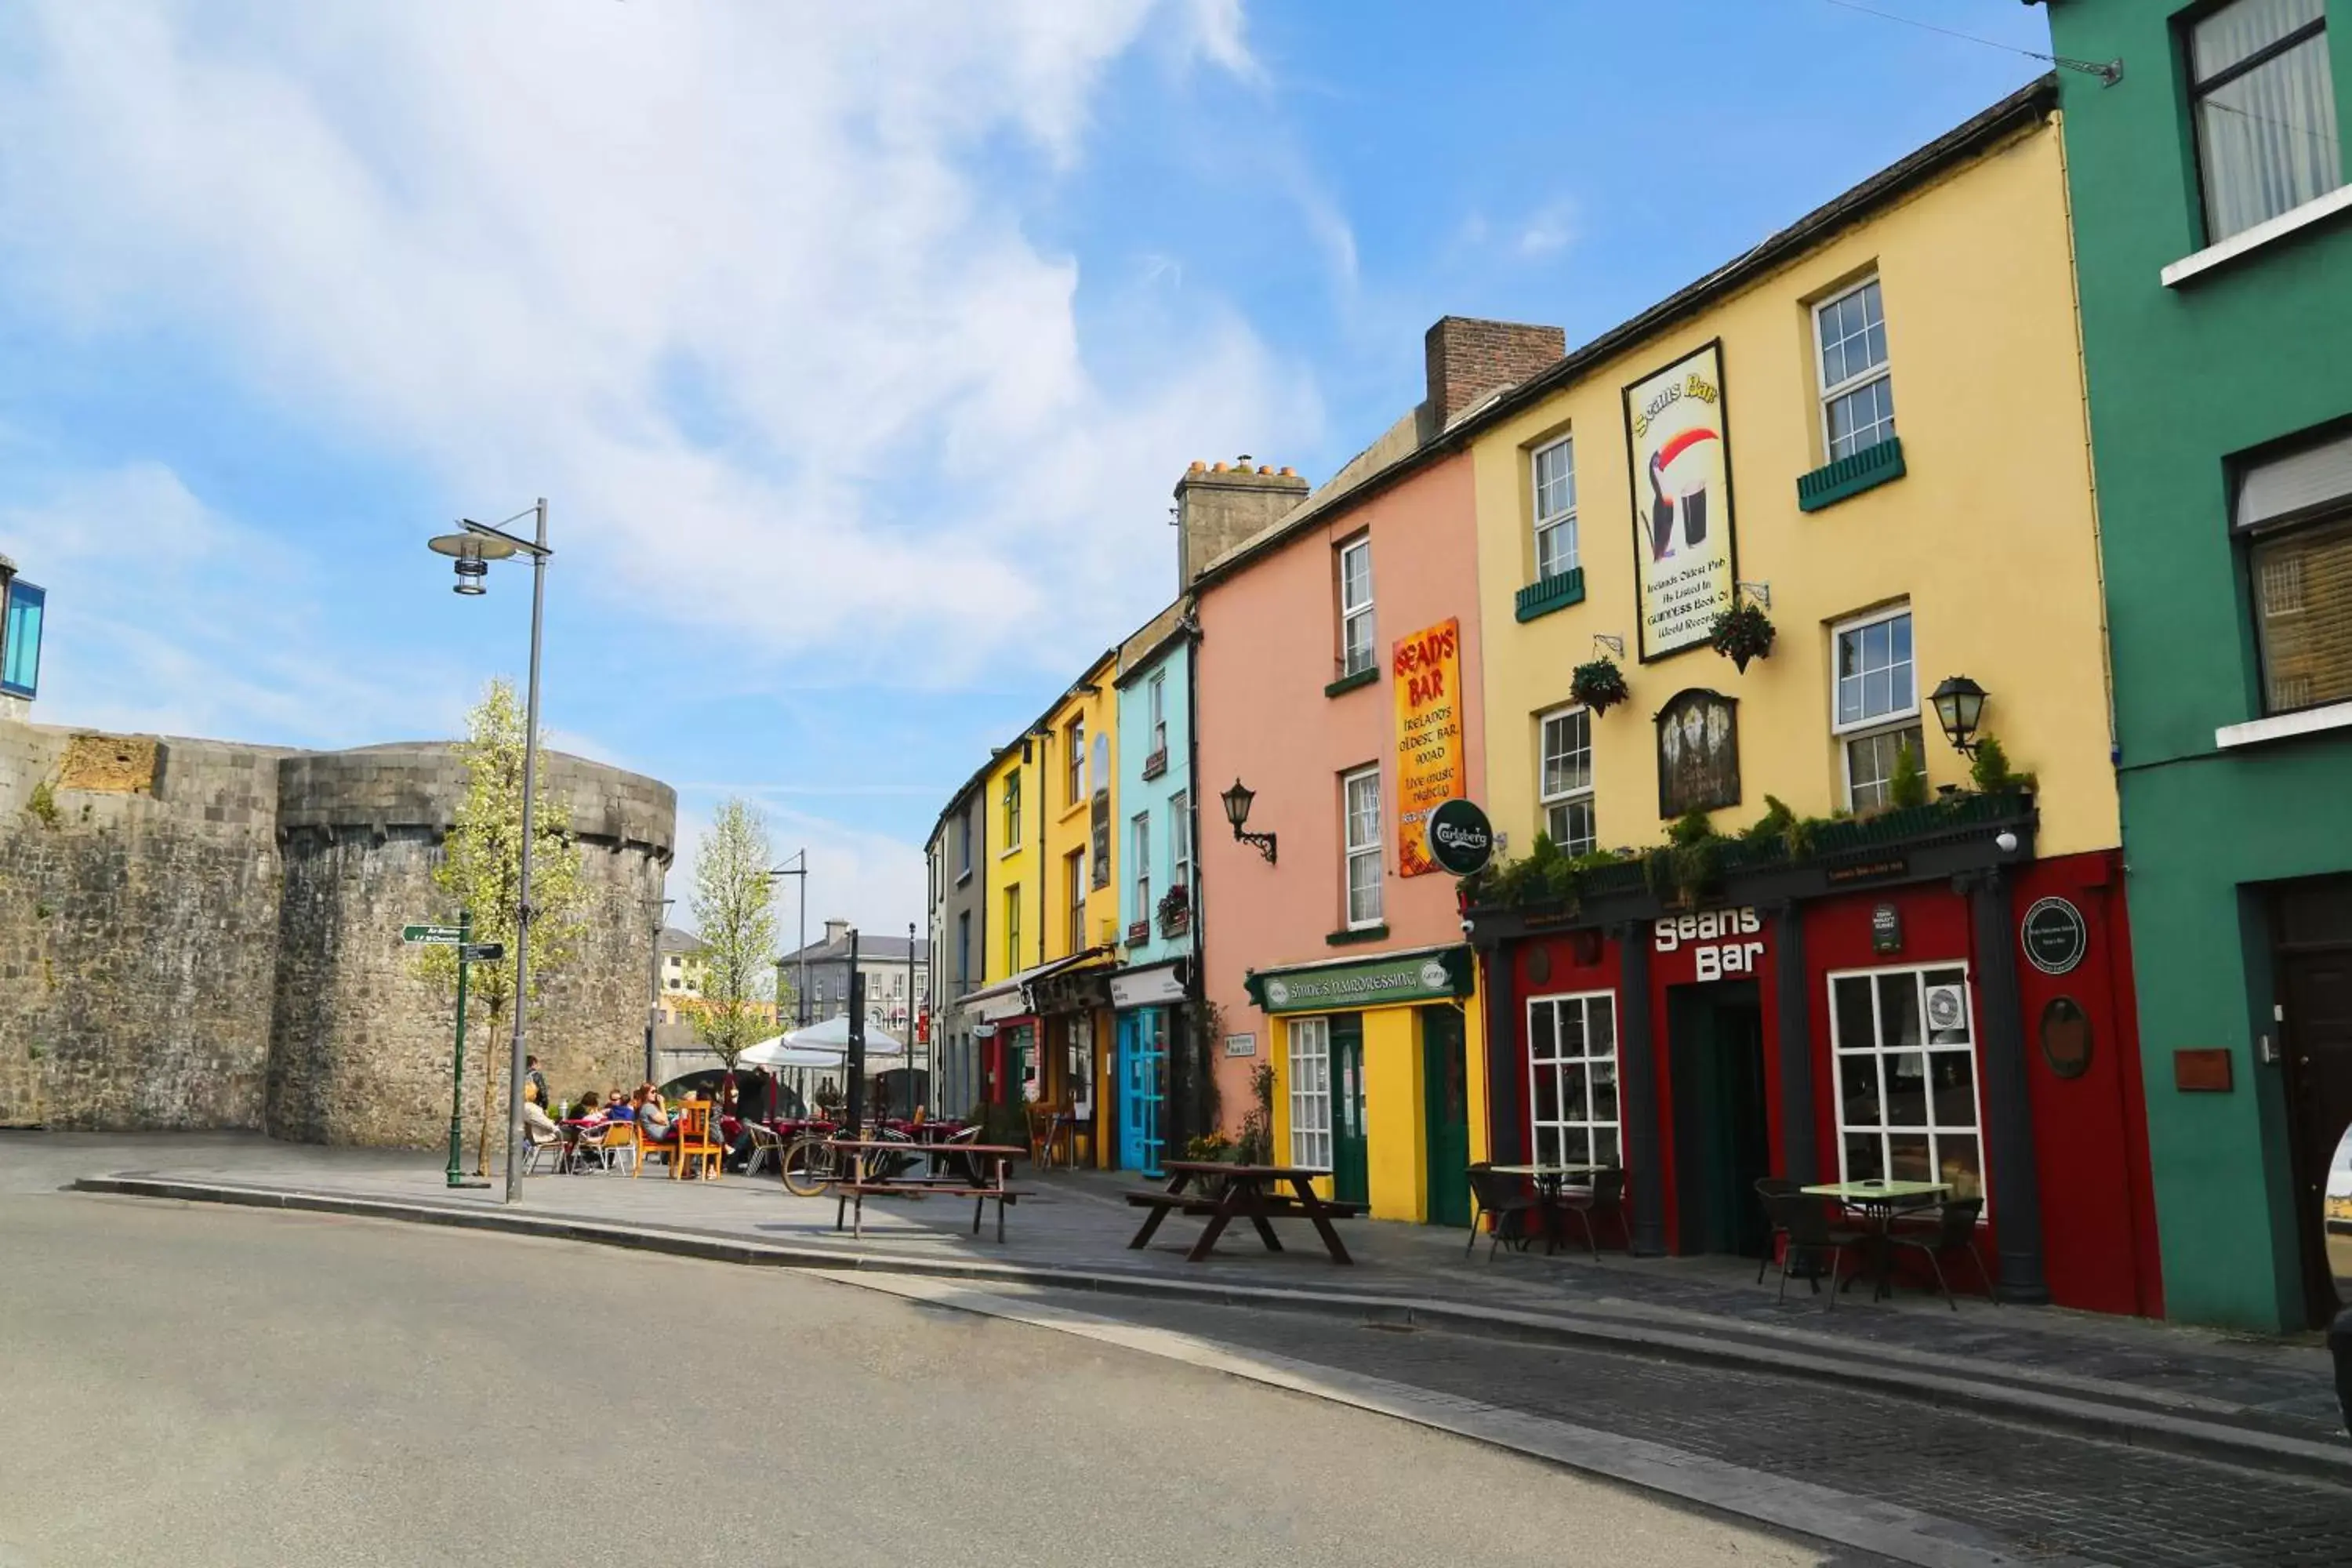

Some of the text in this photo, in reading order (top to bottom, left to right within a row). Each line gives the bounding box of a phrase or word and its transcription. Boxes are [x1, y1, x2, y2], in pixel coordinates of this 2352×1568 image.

[1684, 373, 1718, 404] Bar
[1708, 557, 1726, 572] Pub
[1675, 583, 1700, 600] Listed
[1407, 668, 1445, 708] BAR
[1437, 822, 1487, 848] Carlsberg
[1655, 906, 1760, 952] Seans
[1695, 942, 1764, 982] Bar
